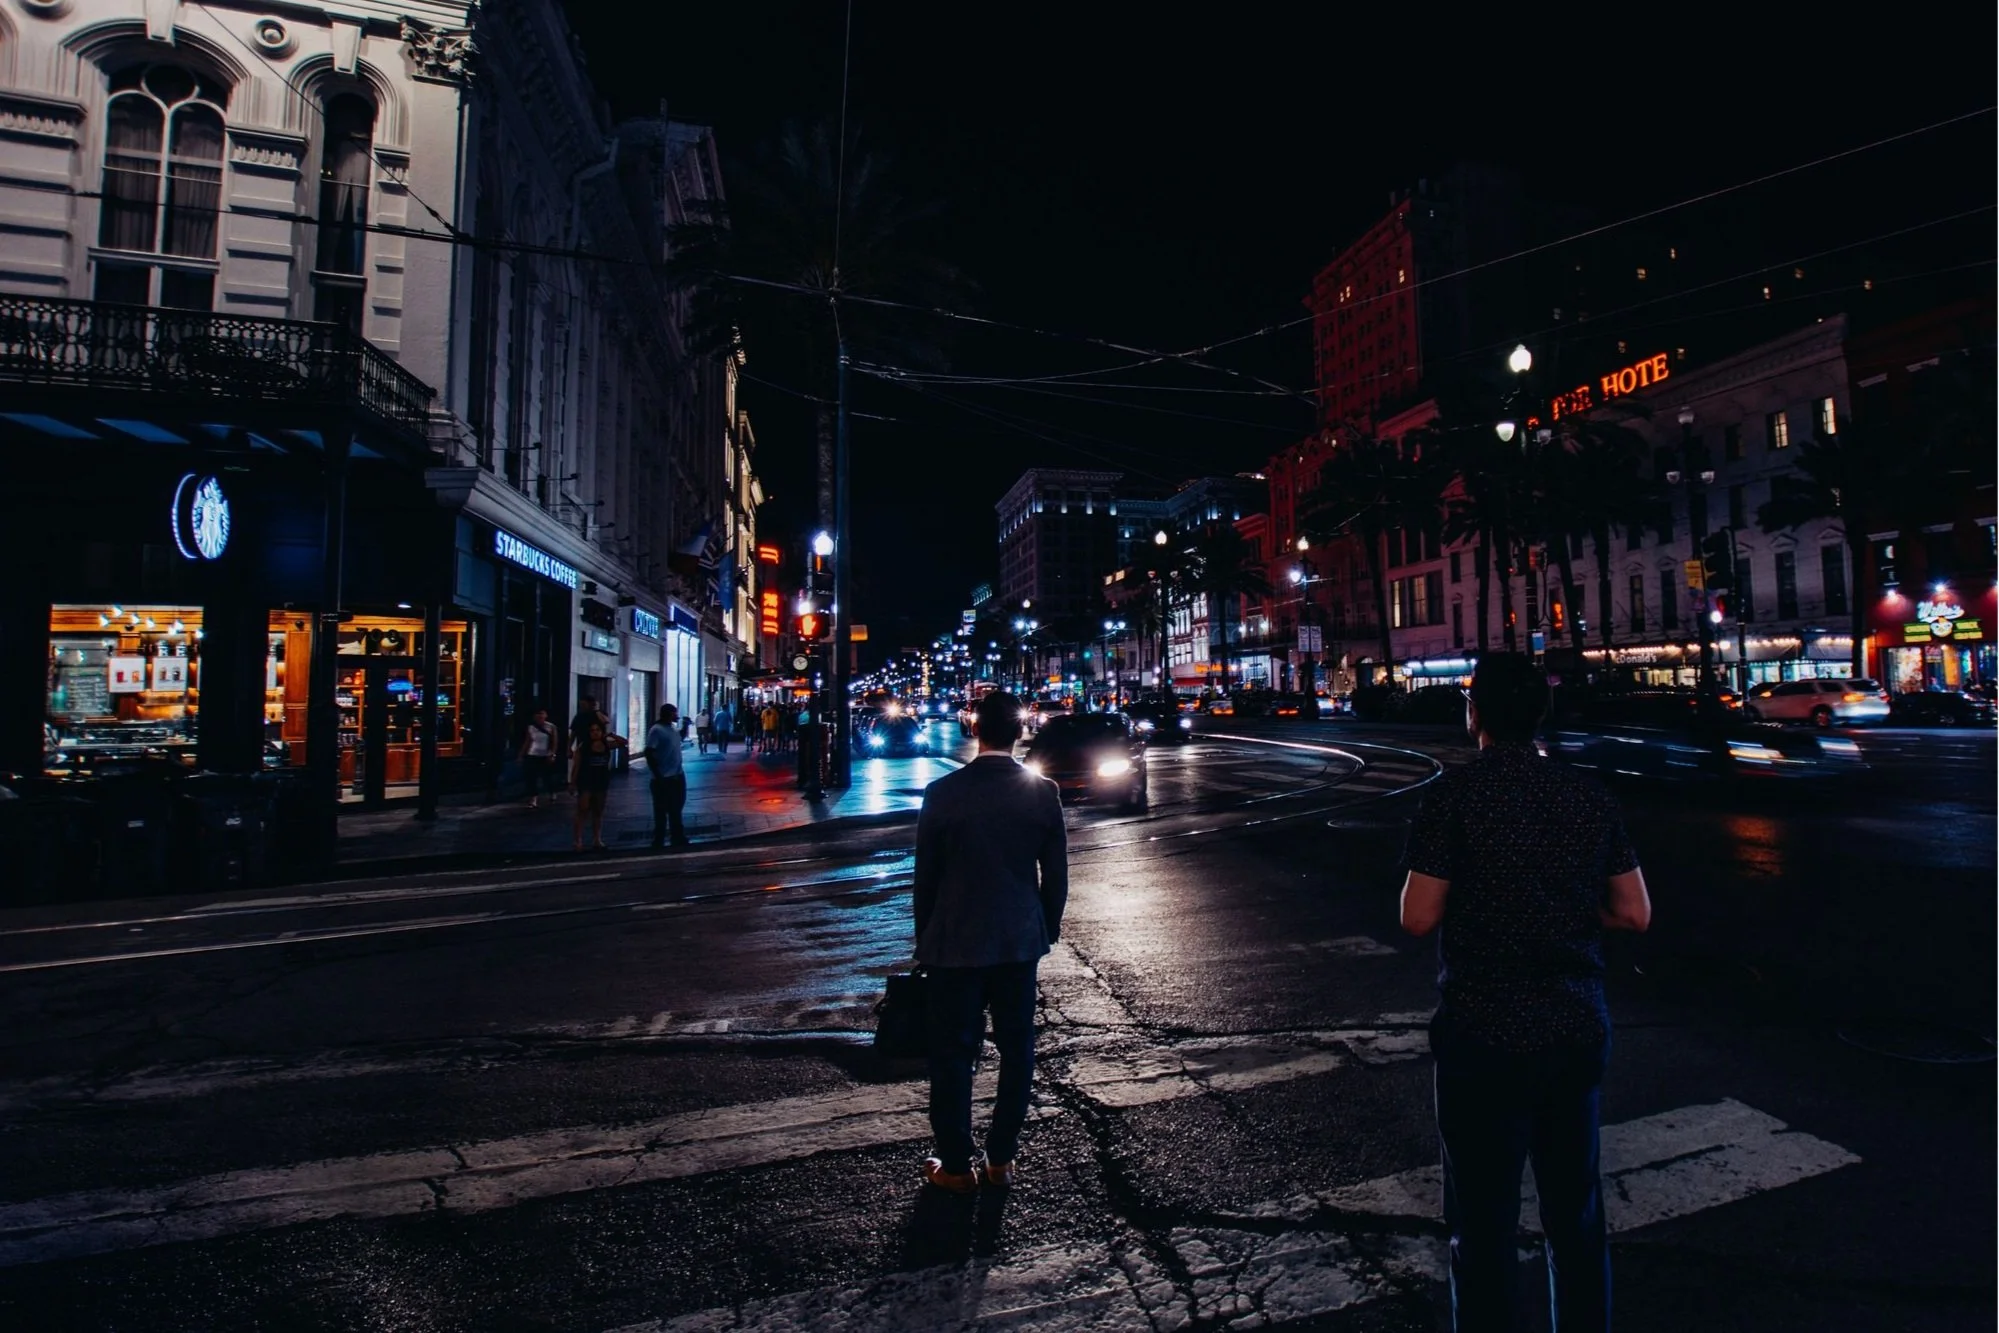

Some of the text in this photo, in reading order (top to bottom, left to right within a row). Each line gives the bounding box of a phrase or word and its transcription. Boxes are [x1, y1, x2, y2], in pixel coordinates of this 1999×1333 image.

[495, 531, 577, 589] STARBUCKS COFFEE
[1614, 653, 1658, 664] cDonald's
